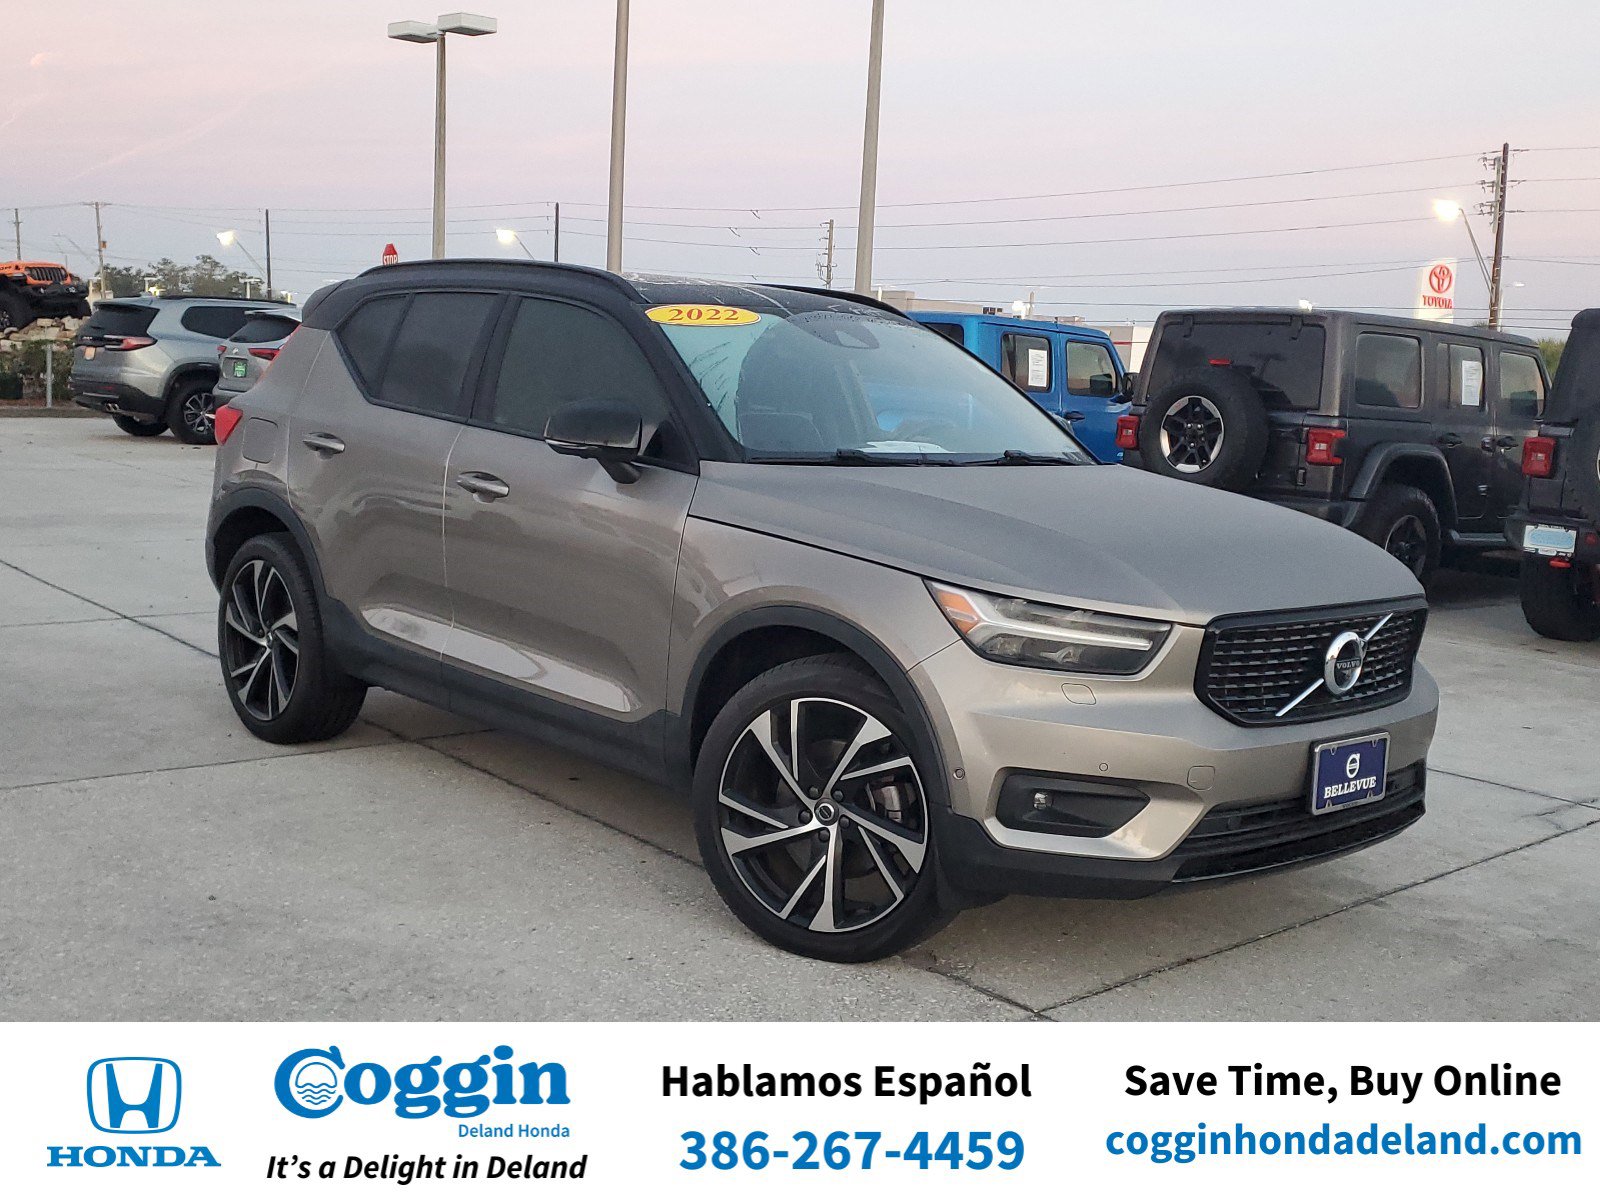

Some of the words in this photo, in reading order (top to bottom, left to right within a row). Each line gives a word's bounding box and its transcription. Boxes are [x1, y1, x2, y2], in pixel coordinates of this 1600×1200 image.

[384, 254, 398, 265] STOP
[1422, 294, 1453, 309] TOYOTA
[668, 308, 740, 321] 2022
[1336, 661, 1360, 669] VOLVO
[1323, 776, 1377, 799] BELLEVUE
